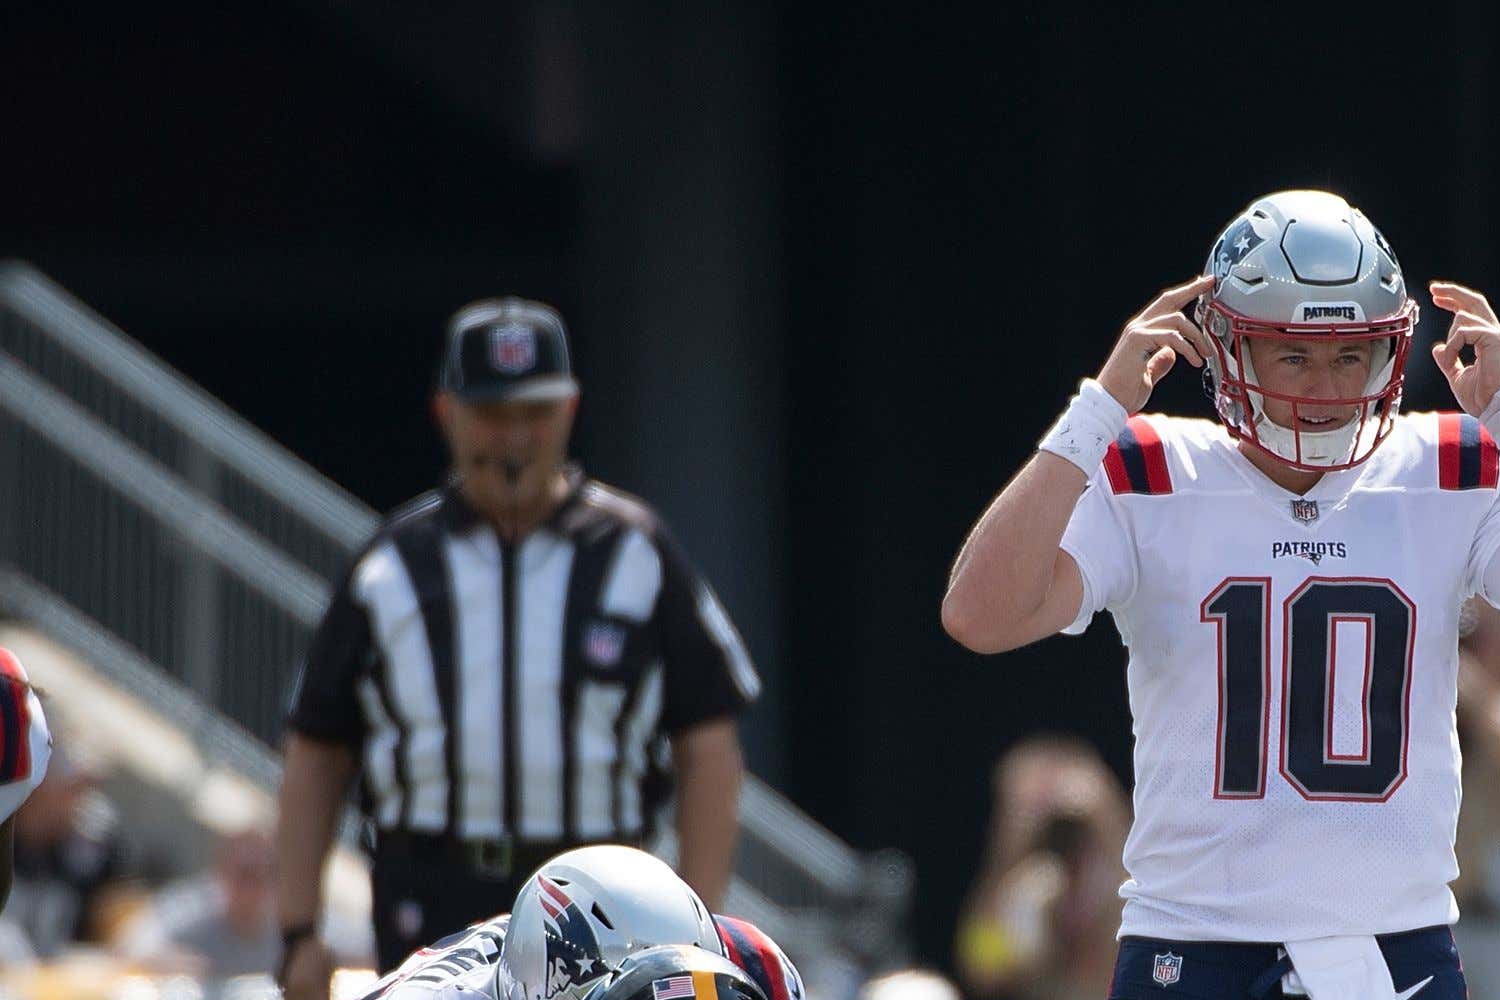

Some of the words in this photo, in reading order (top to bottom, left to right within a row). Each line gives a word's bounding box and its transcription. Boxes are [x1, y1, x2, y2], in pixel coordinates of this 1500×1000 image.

[1303, 307, 1355, 321] PATRIOTS
[1295, 507, 1317, 519] NFL
[1272, 541, 1347, 559] PATRIOTS
[1200, 576, 1417, 803] 10
